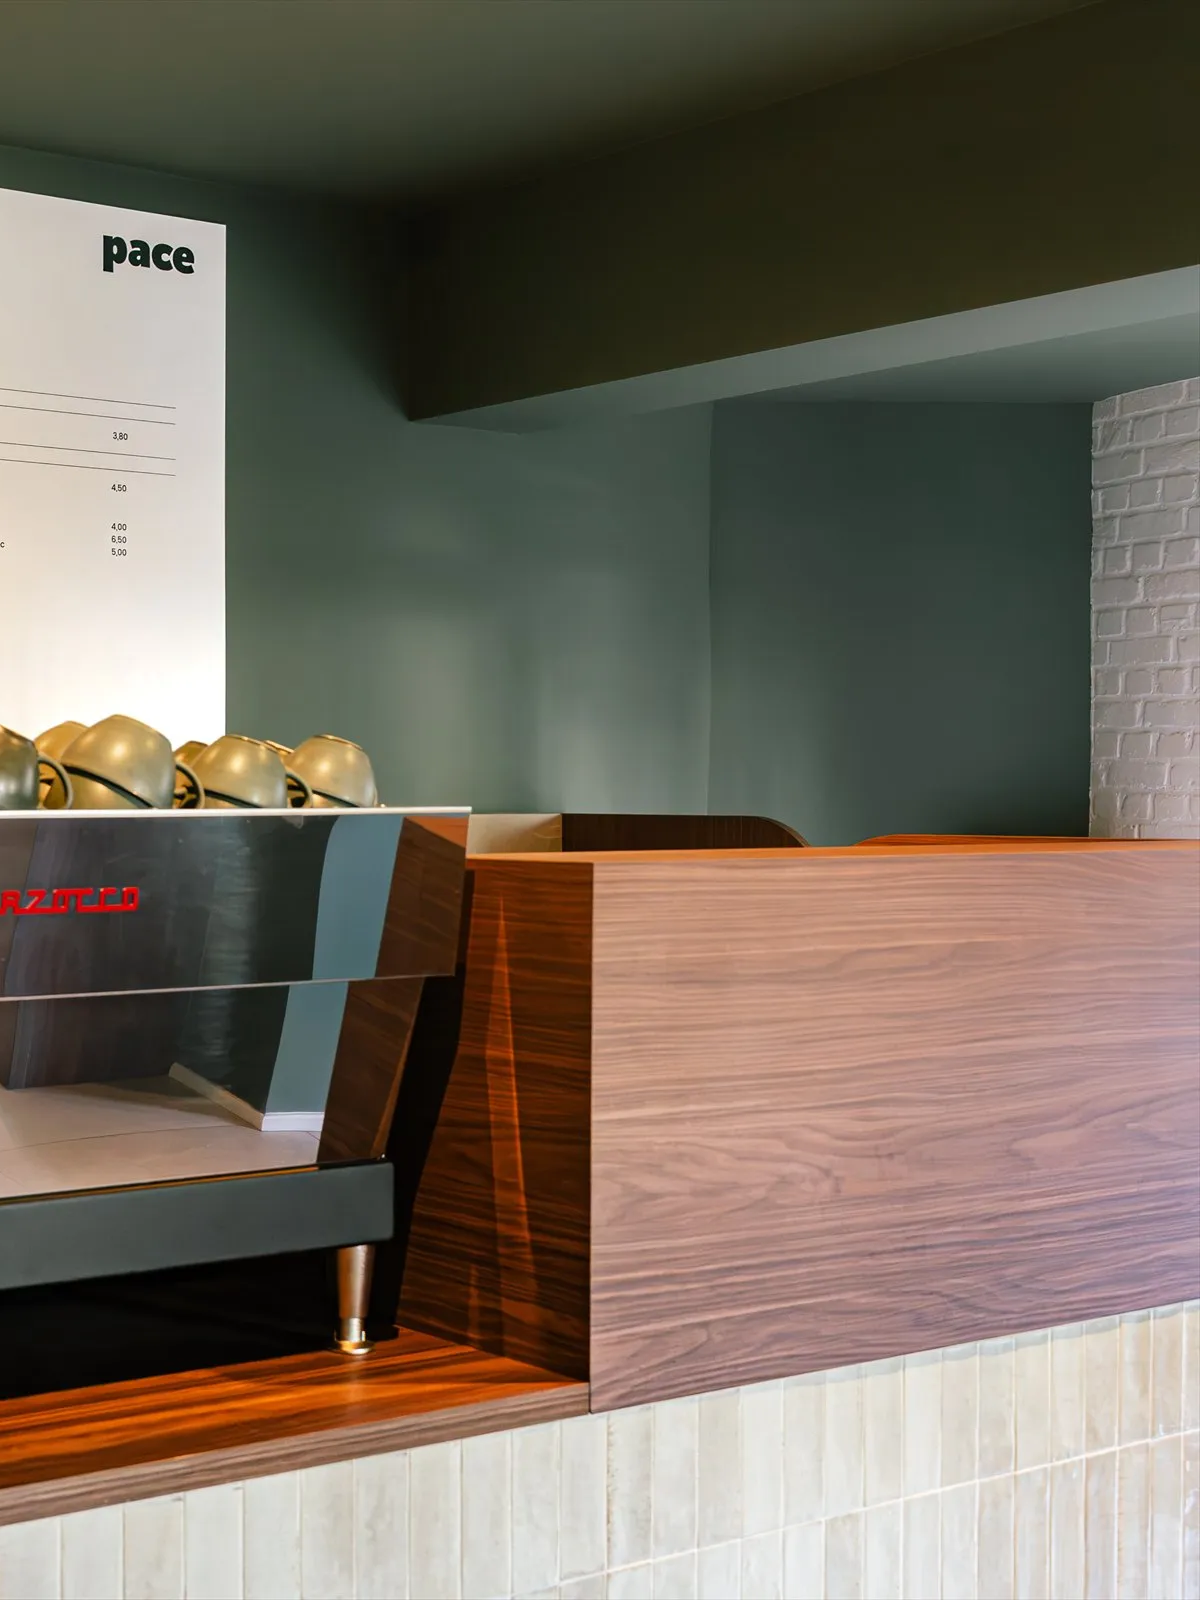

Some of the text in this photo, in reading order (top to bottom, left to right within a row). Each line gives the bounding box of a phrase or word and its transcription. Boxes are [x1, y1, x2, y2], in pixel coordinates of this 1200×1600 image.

[103, 235, 195, 275] pace
[112, 431, 129, 440] 3,80
[110, 482, 127, 492] 4,50
[110, 521, 127, 531] 4,00
[110, 534, 127, 544] 6,50
[110, 547, 127, 556] 5,00
